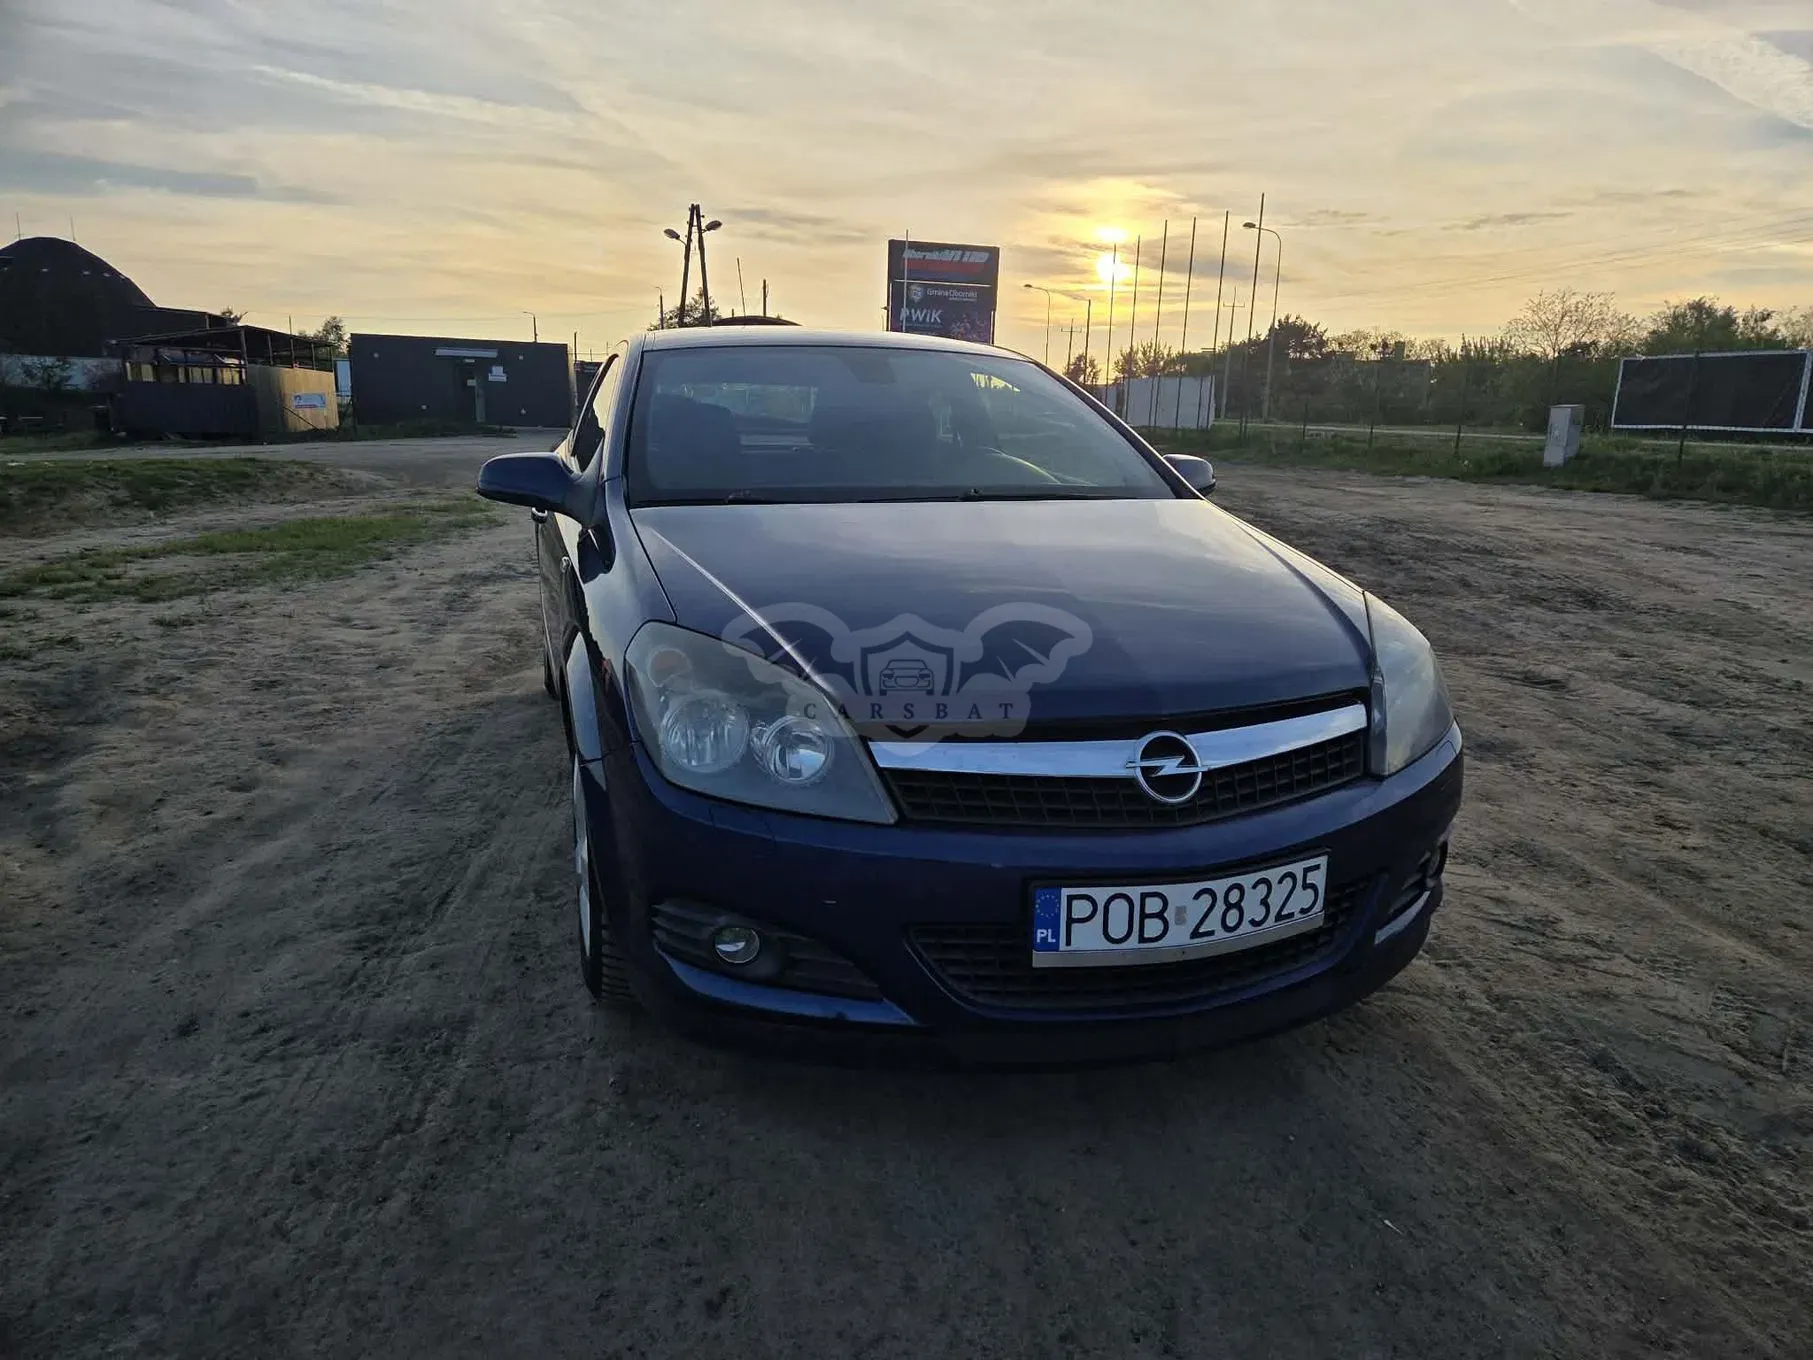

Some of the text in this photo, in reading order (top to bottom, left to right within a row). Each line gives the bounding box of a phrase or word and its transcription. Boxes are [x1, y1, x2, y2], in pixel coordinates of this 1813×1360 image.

[1065, 863, 1322, 946] POB 28325
[1036, 928, 1056, 943] PL
